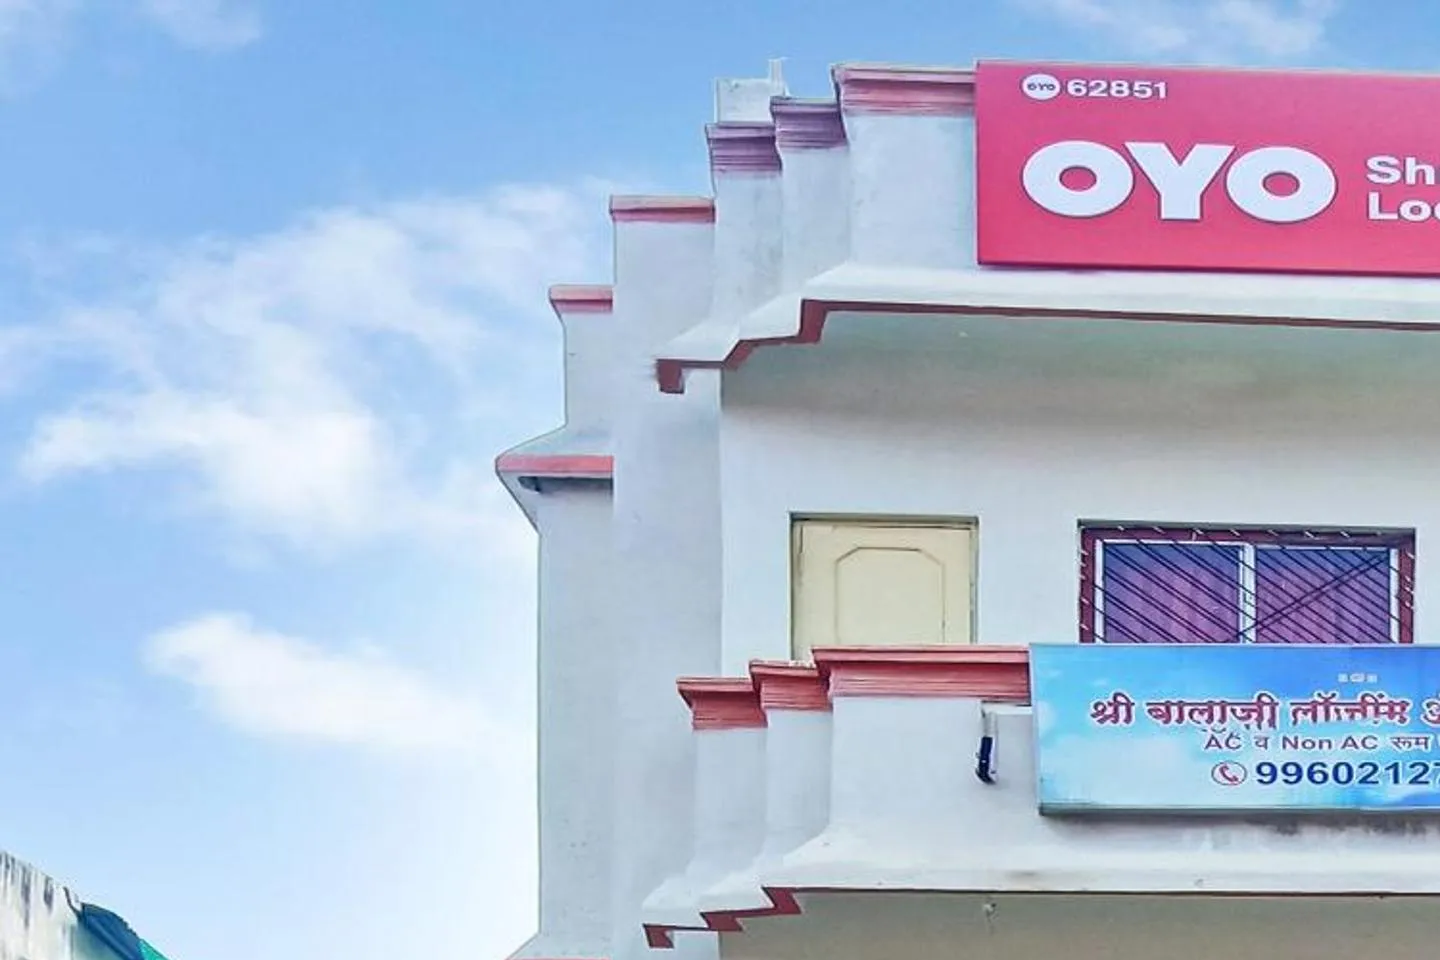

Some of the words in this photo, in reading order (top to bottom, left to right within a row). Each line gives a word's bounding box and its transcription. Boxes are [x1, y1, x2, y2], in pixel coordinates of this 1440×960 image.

[1067, 79, 1167, 99] 62851
[1022, 139, 1337, 223] OYO
[1089, 691, 1135, 726] श्री
[1146, 691, 1280, 729] बालाजी
[1204, 734, 1241, 751] AC
[1254, 735, 1270, 751] व
[1281, 735, 1332, 751] Non
[1340, 735, 1379, 750] AC
[1390, 735, 1431, 751] रूम
